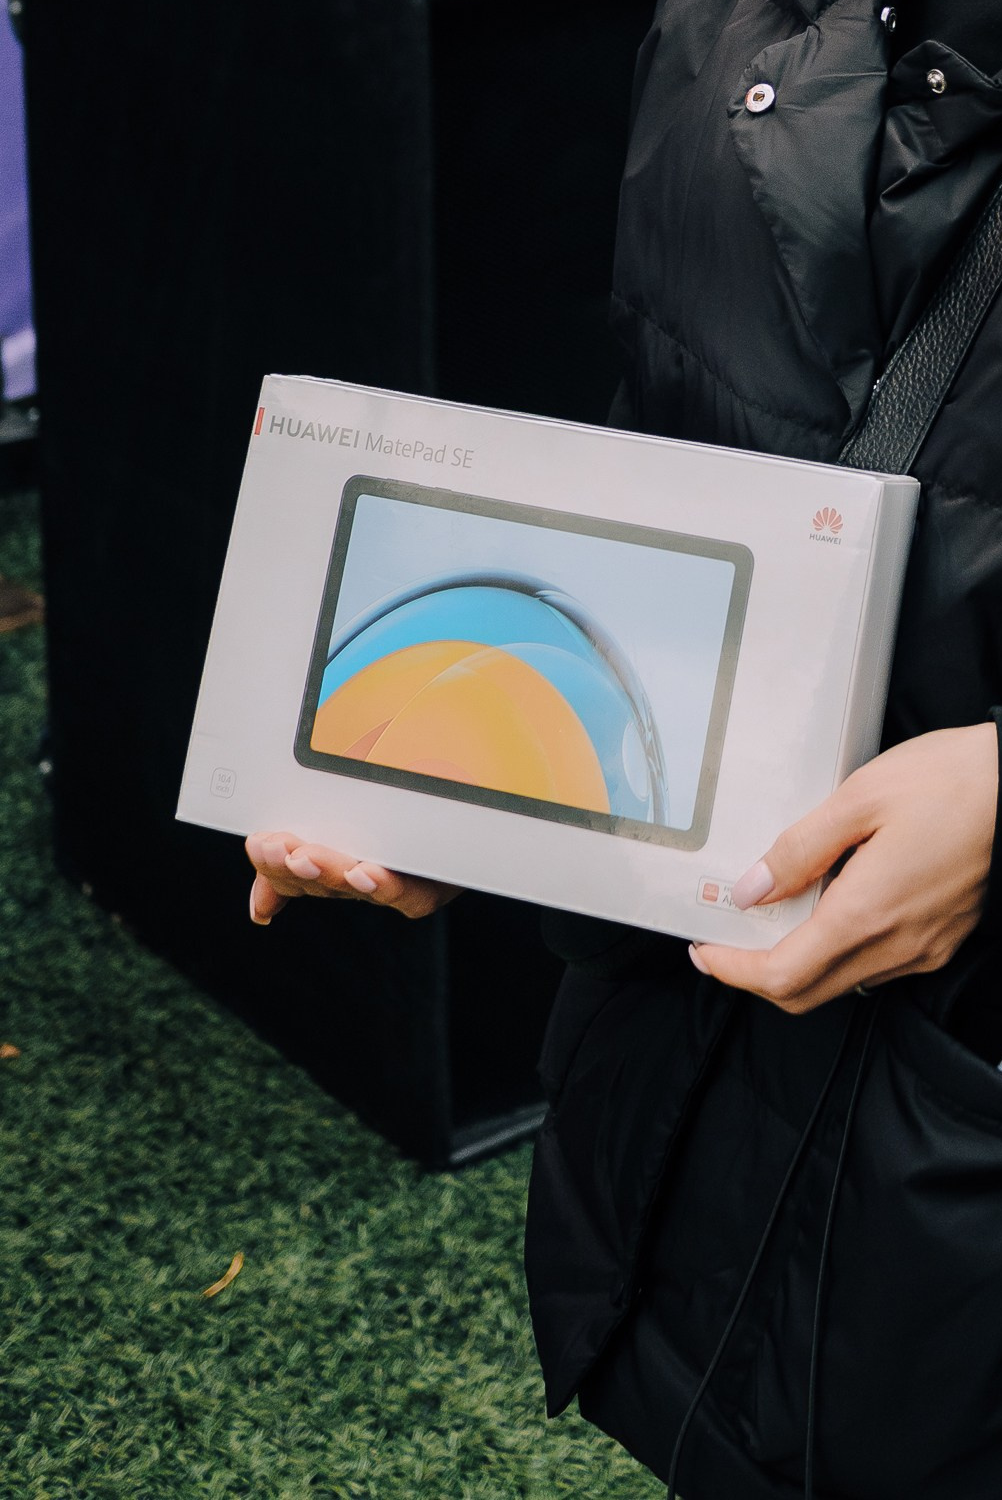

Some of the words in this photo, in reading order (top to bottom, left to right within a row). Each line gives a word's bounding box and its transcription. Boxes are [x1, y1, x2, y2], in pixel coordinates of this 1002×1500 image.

[269, 415, 360, 448] HUAWEI
[365, 432, 447, 463] MatePad
[451, 448, 475, 469] SE
[809, 534, 842, 545] HUAWEI
